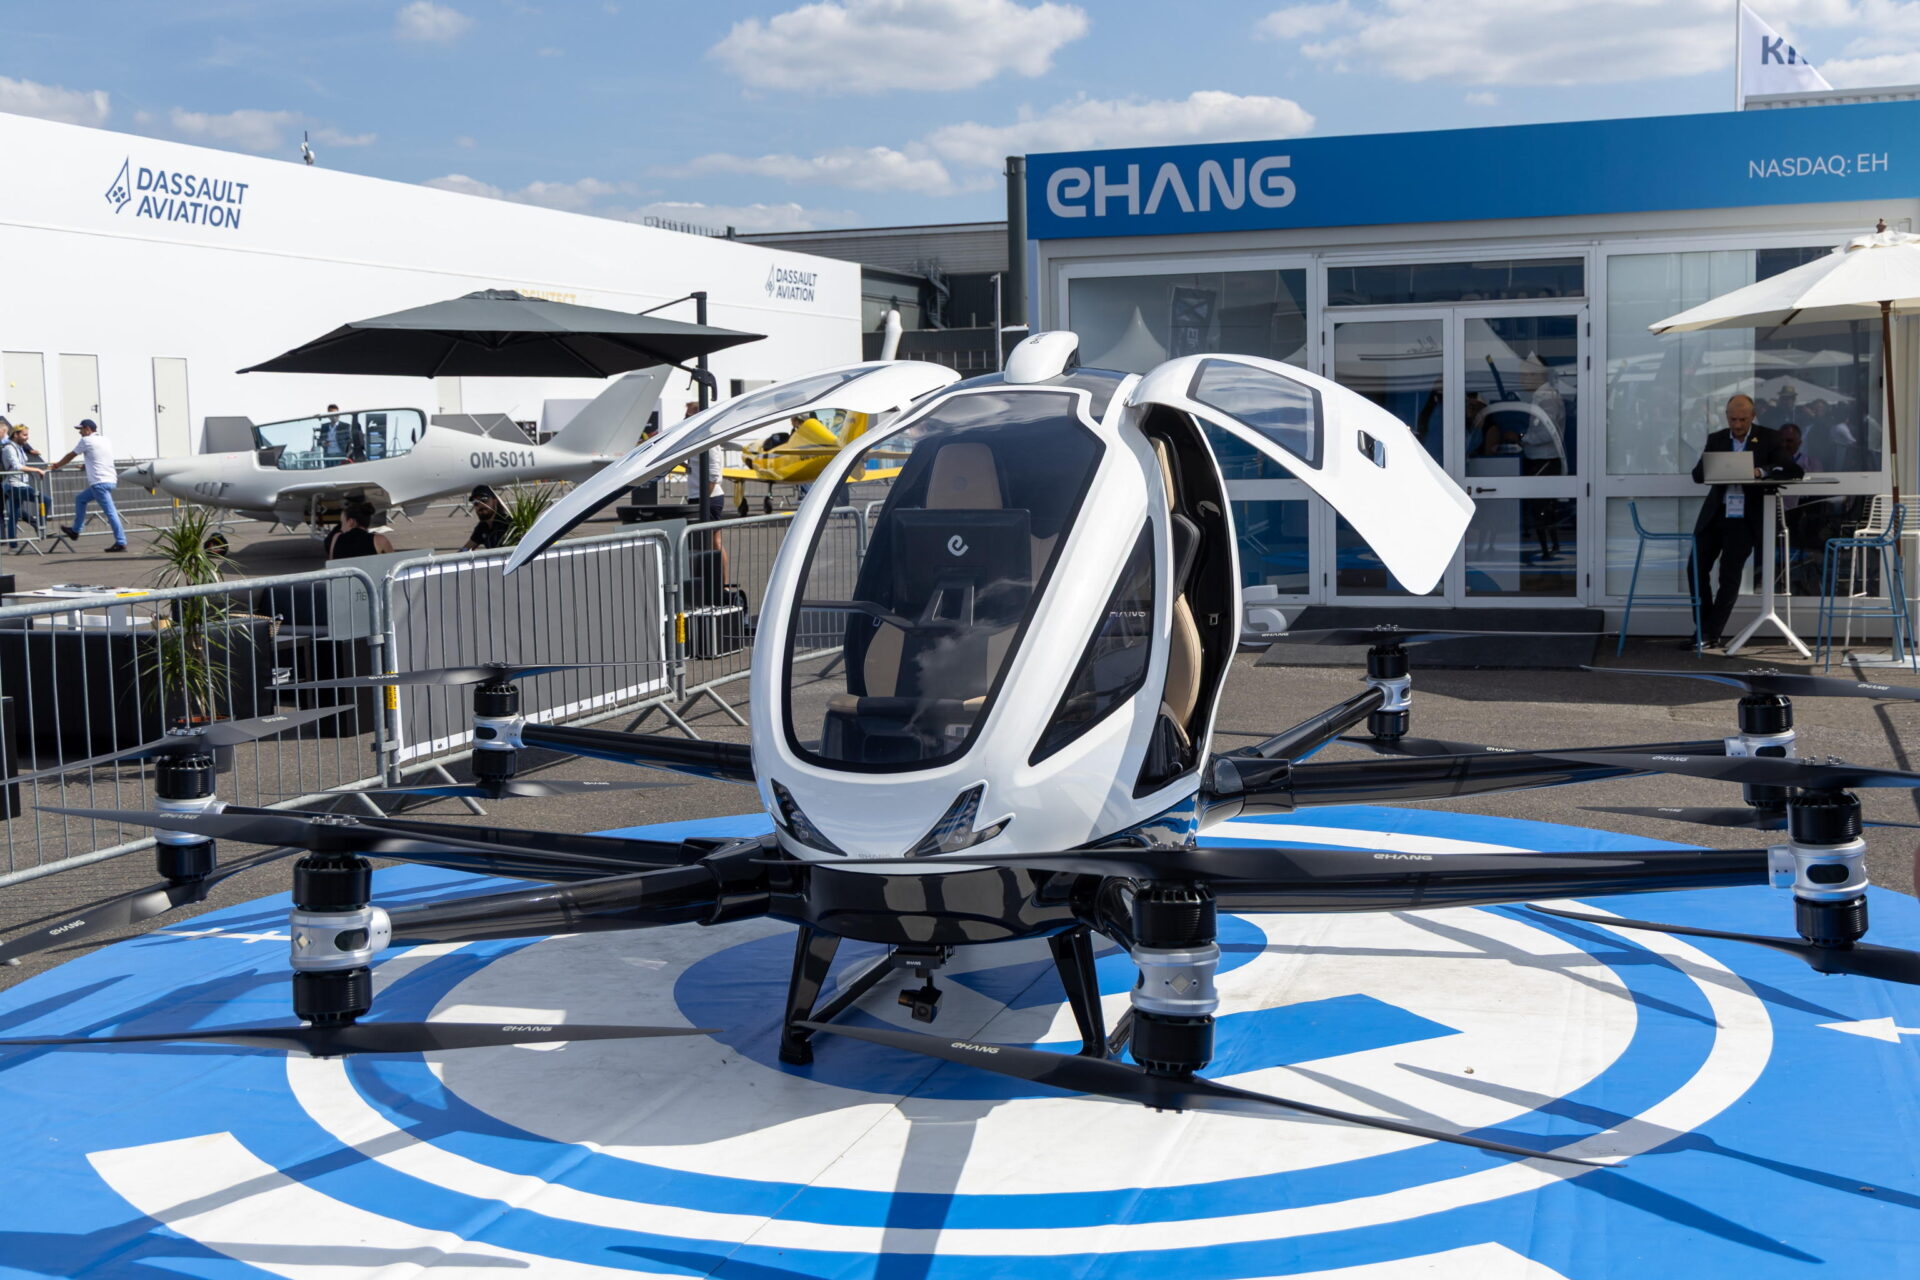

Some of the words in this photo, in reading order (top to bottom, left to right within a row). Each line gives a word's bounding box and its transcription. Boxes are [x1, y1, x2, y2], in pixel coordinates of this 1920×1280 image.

[1749, 154, 1851, 179] NASDAQ:
[1857, 152, 1888, 173] EH
[136, 167, 249, 205] DASSAULT
[136, 195, 241, 229] AVIATION
[776, 267, 818, 287] DASSAULT
[776, 285, 815, 302] AVIATION
[470, 451, 535, 469] OM-S011
